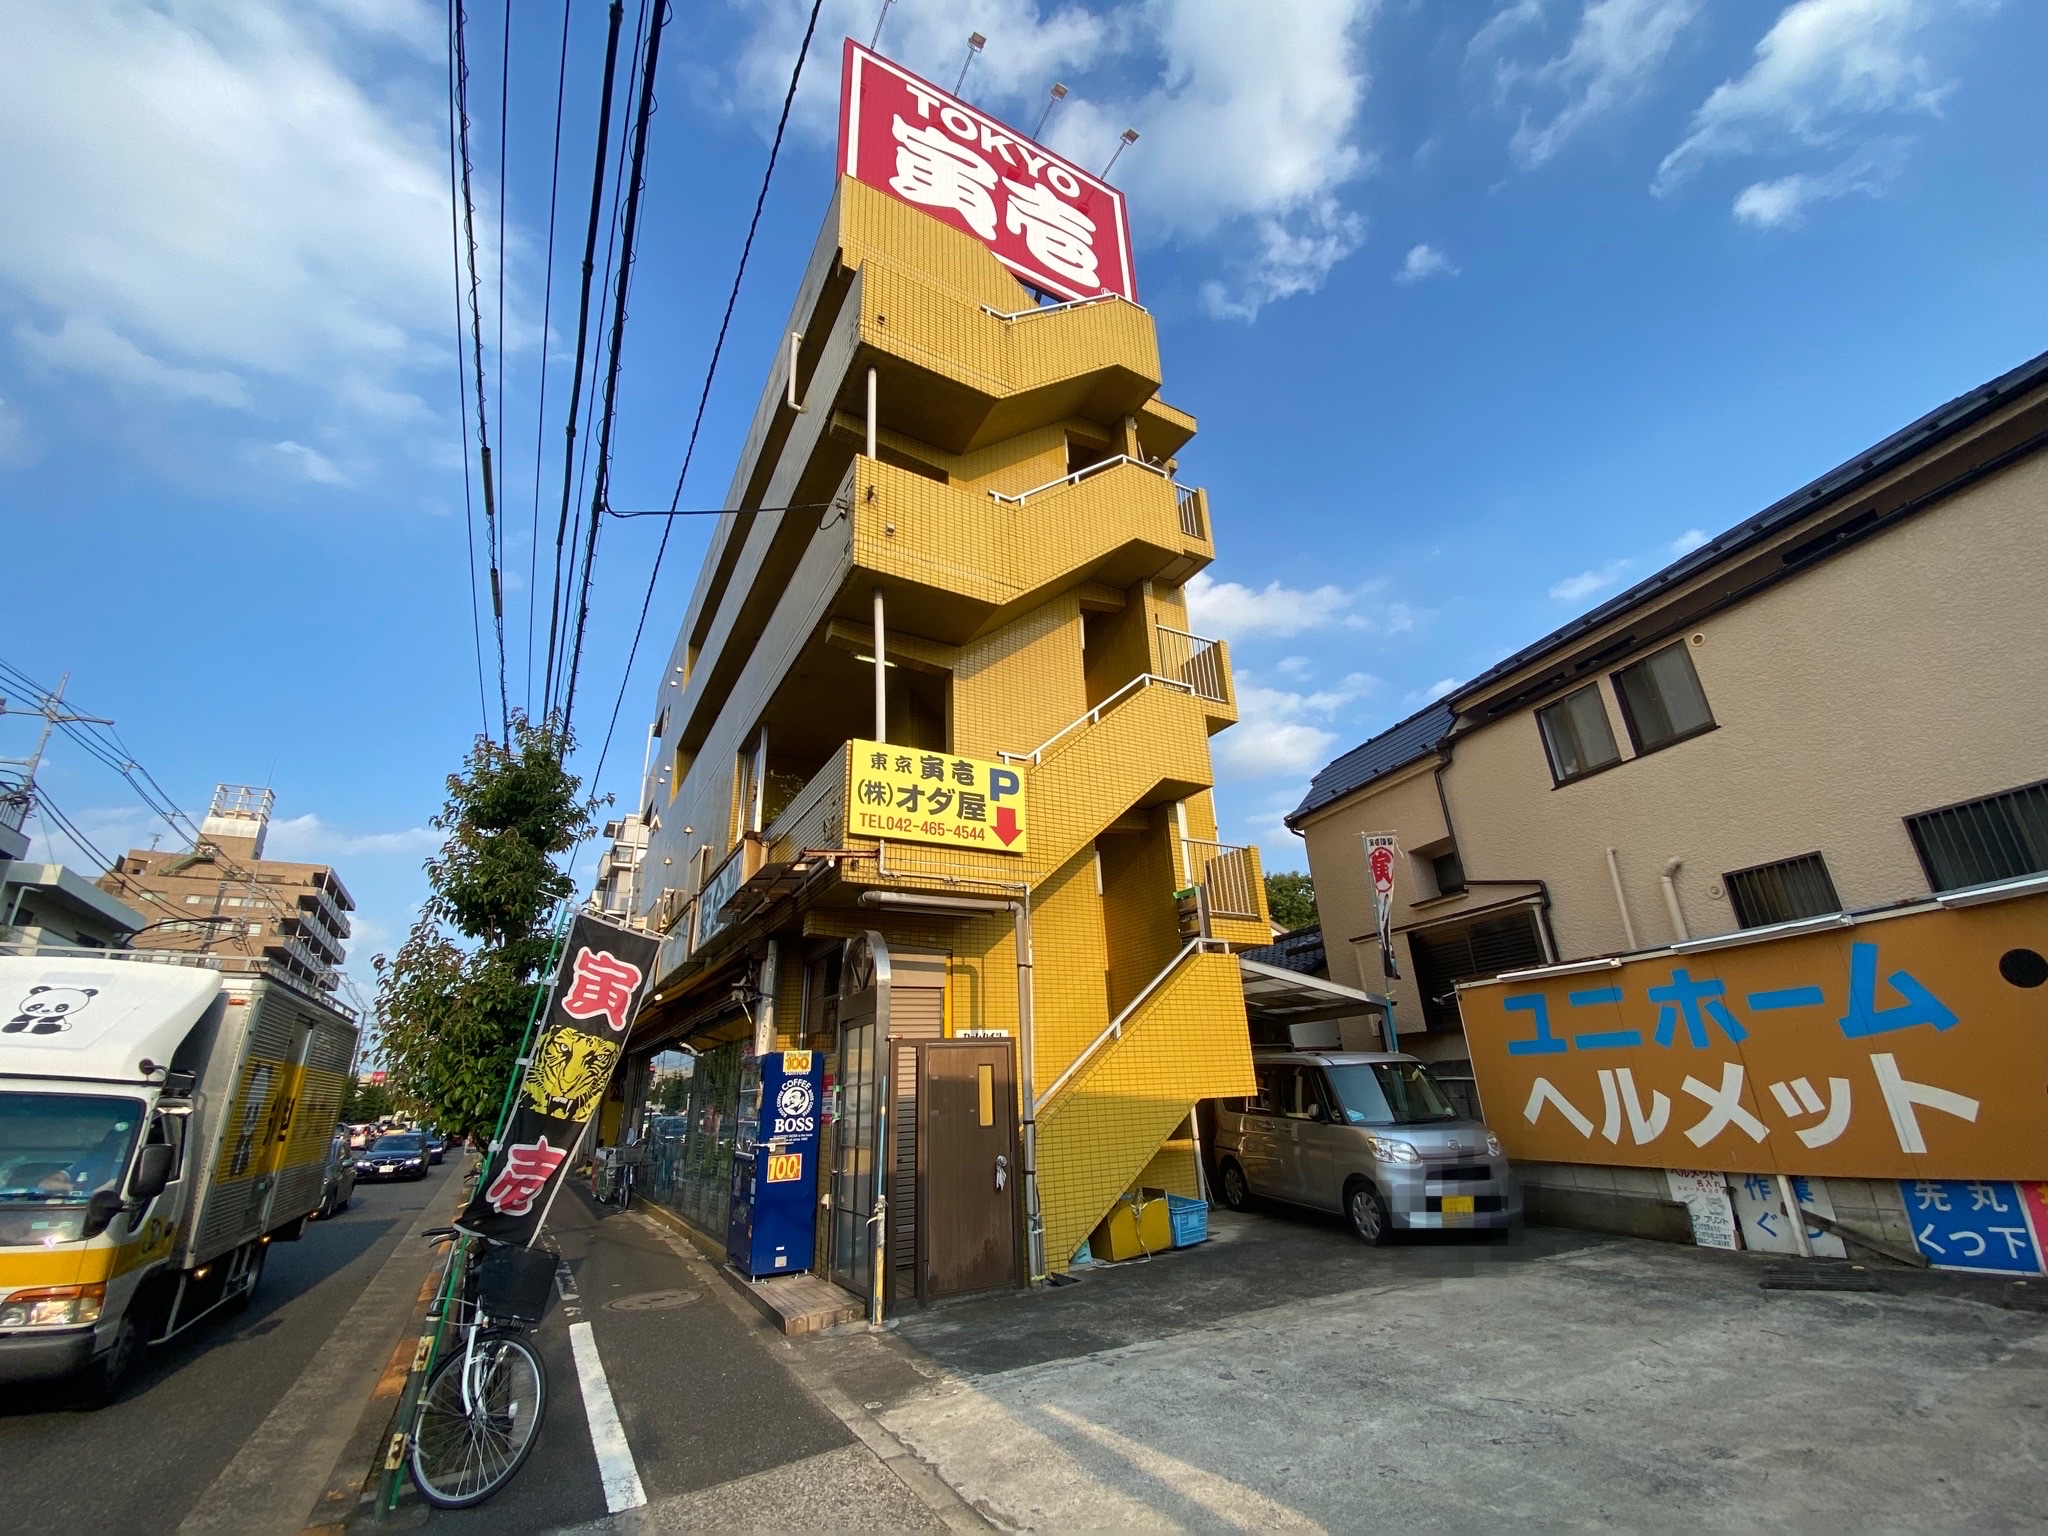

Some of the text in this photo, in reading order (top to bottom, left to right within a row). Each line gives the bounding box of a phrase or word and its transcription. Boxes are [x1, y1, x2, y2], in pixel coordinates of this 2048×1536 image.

[906, 83, 1080, 198] TOKYO
[888, 113, 1101, 288] 寅壱
[857, 778, 987, 823] (株)オダ屋
[989, 767, 1020, 802] P
[1503, 942, 1961, 1056] ユニホーム
[781, 1078, 812, 1091] COFFEE
[1523, 1052, 1980, 1155] ヘルメット
[774, 1117, 814, 1133] BOSS
[1914, 1180, 2009, 1213] 先丸
[1917, 1223, 2027, 1259] くつ下
